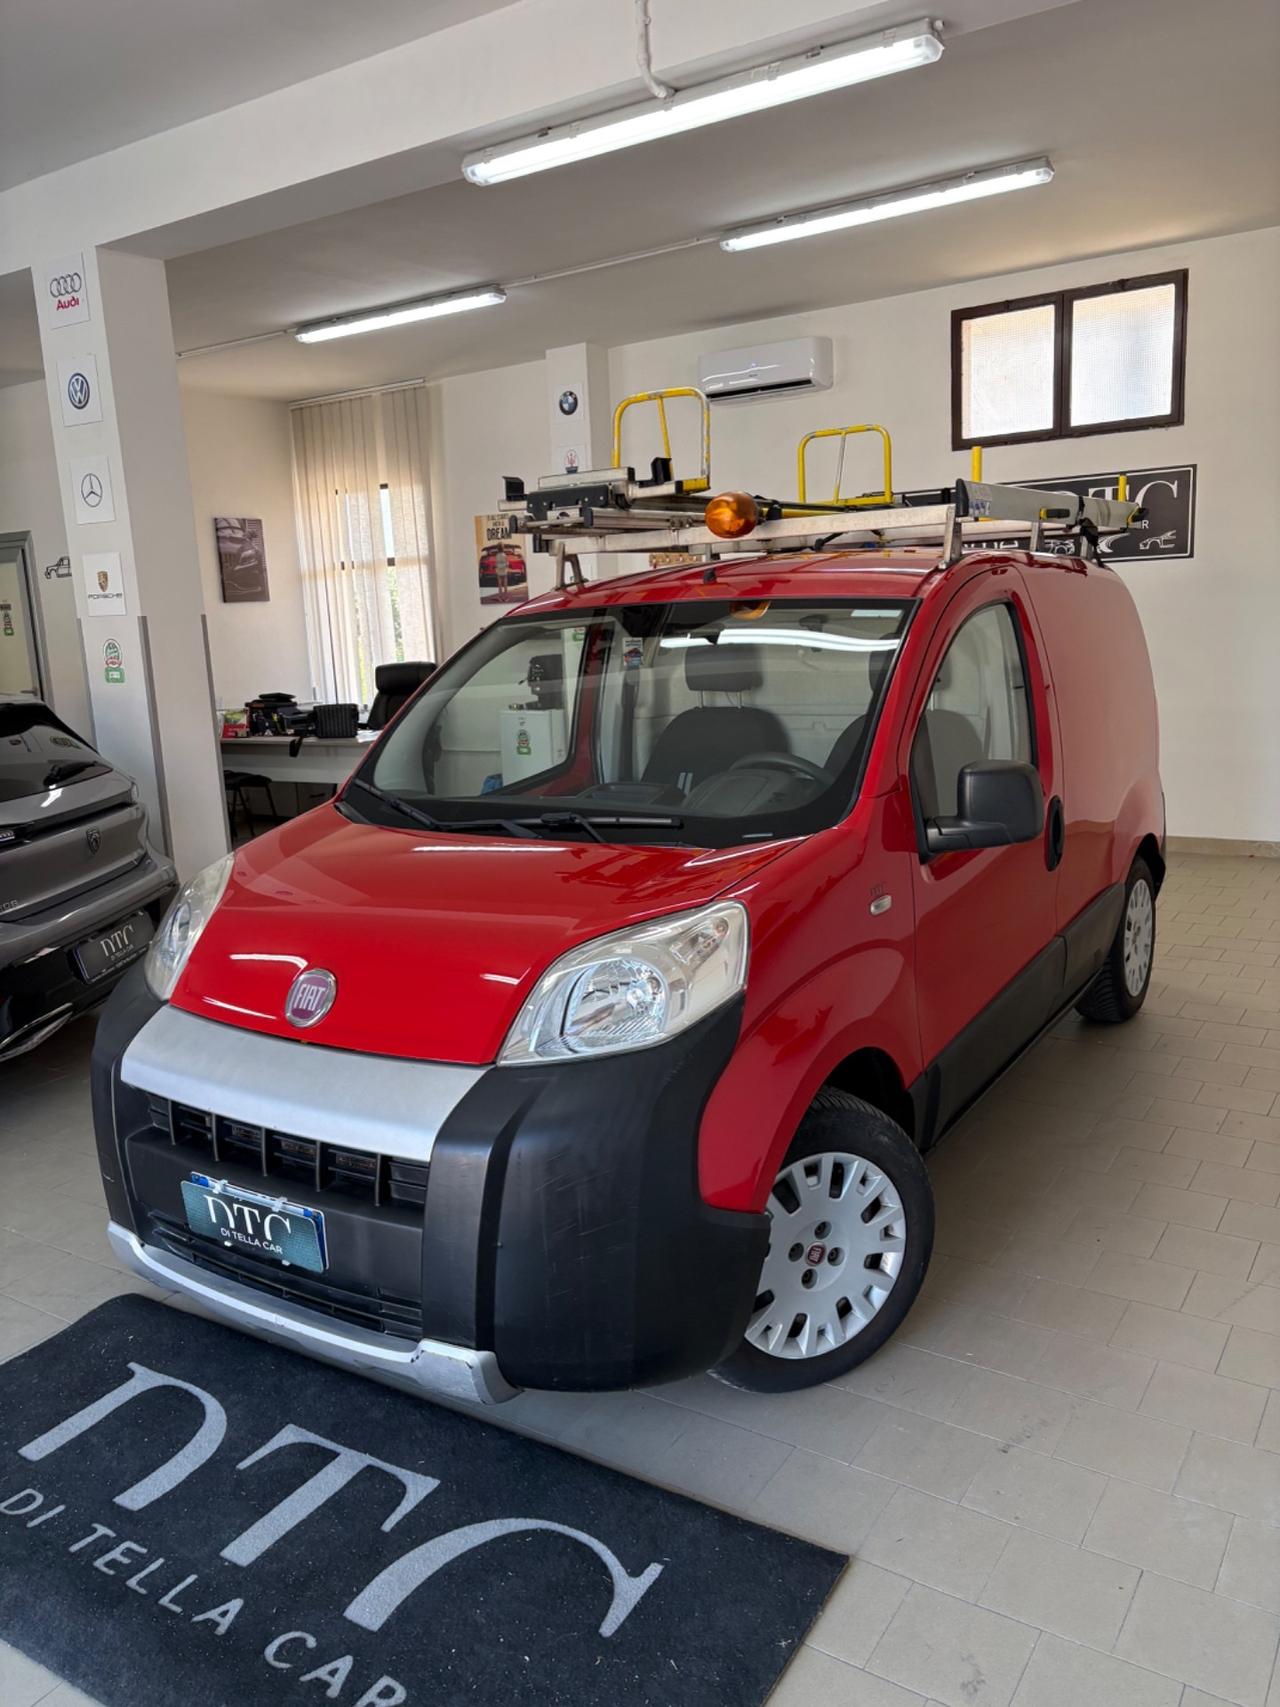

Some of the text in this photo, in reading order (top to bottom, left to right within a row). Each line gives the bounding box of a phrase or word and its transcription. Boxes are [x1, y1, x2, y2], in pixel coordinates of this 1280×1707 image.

[56, 296, 80, 311] Audi
[293, 983, 327, 1011] FIAT
[203, 1194, 292, 1241] DTC
[220, 1227, 283, 1254] DI TELLA CAR
[18, 1362, 664, 1638] DTC
[0, 1488, 409, 1707] DI TELLA CAR
